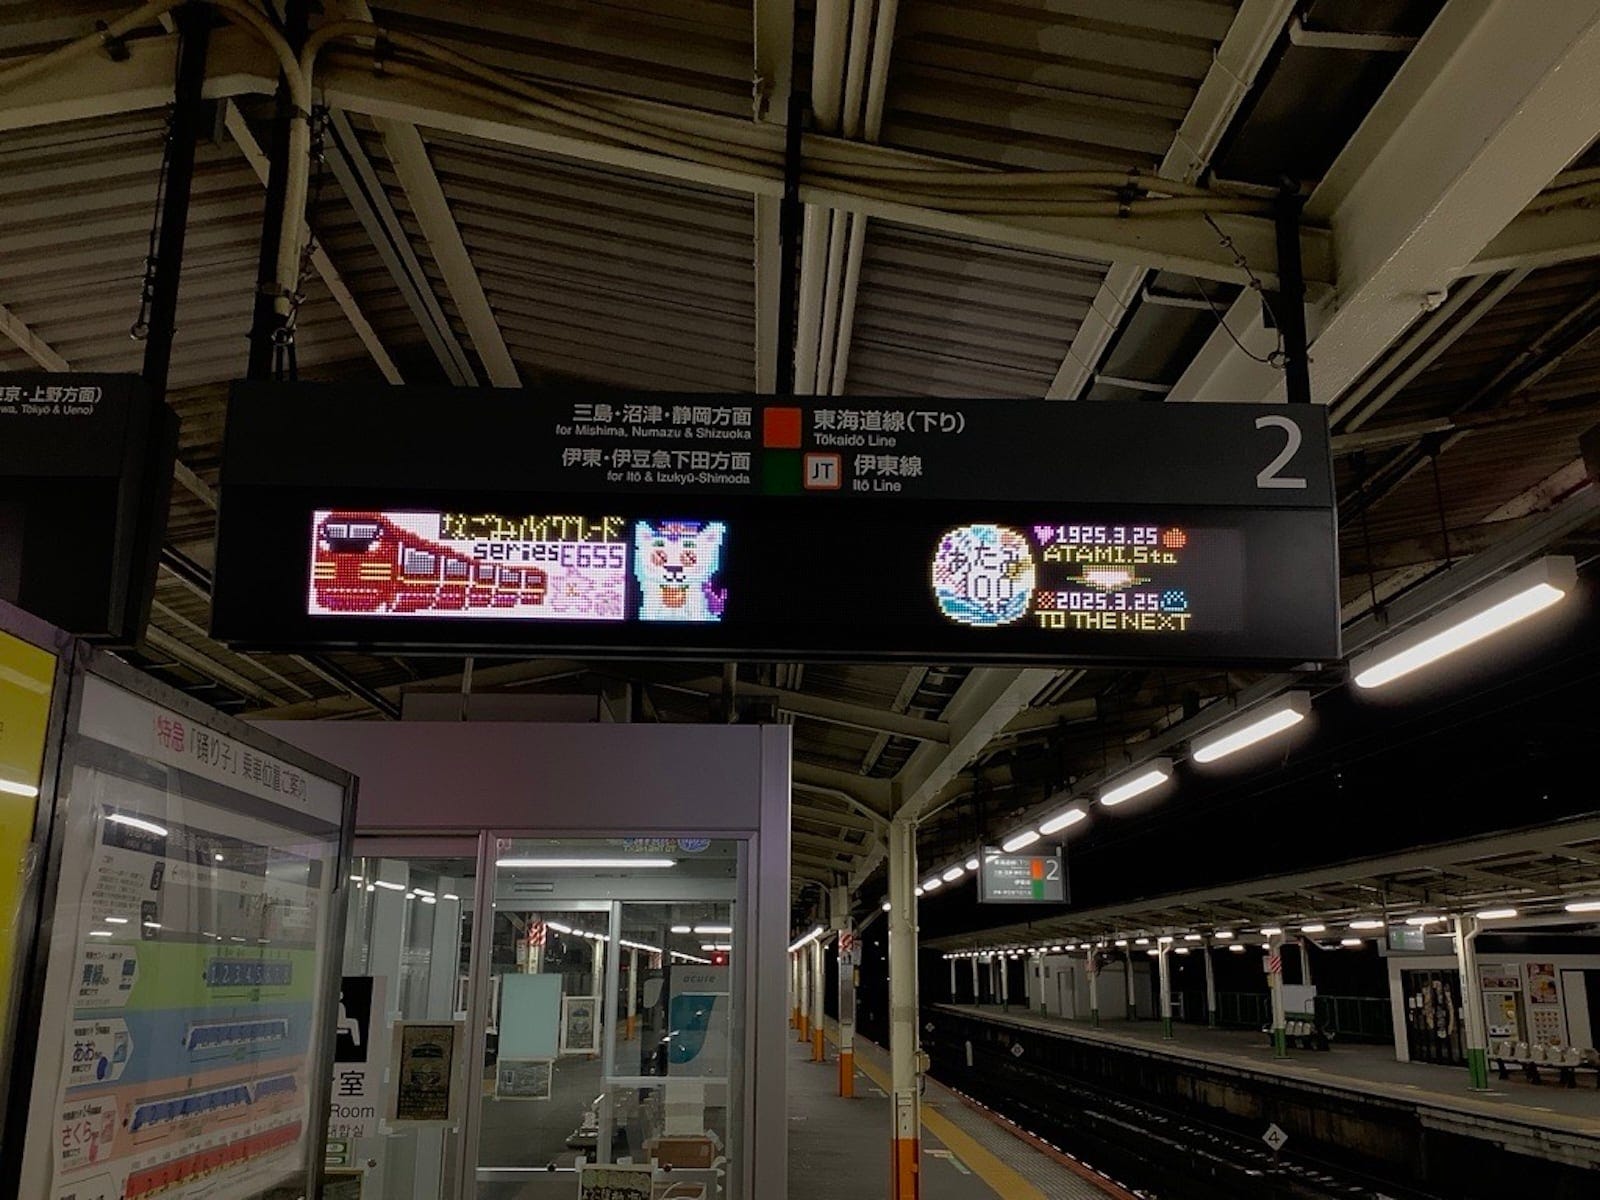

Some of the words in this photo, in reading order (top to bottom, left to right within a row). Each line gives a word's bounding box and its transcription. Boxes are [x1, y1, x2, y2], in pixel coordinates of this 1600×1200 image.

[572, 403, 753, 427] 三島・沼津・静岡方面
[813, 409, 966, 434] 東海道線(下り)
[555, 424, 572, 435] for
[575, 424, 628, 437] Mishima,
[632, 426, 682, 438] Numazu
[684, 427, 693, 438] &
[696, 427, 752, 439] Shizuoka
[868, 433, 896, 447] Line
[562, 447, 751, 471] 伊東・伊豆急下田方面
[1255, 414, 1308, 489] 2
[811, 462, 834, 480] JT
[854, 453, 923, 477] 伊東線
[607, 470, 624, 482] for
[644, 471, 653, 482] &
[873, 479, 902, 492] Line
[1056, 525, 1158, 545] 1925.3.25
[1056, 591, 1159, 610] 2025.3.25
[1035, 611, 1066, 630] TO
[1070, 612, 1117, 630] THE
[1121, 613, 1192, 631] NEXT
[1046, 858, 1060, 881] 2
[332, 1070, 365, 1096] 室
[330, 1103, 375, 1118] Room
[1268, 1130, 1281, 1144] 4
